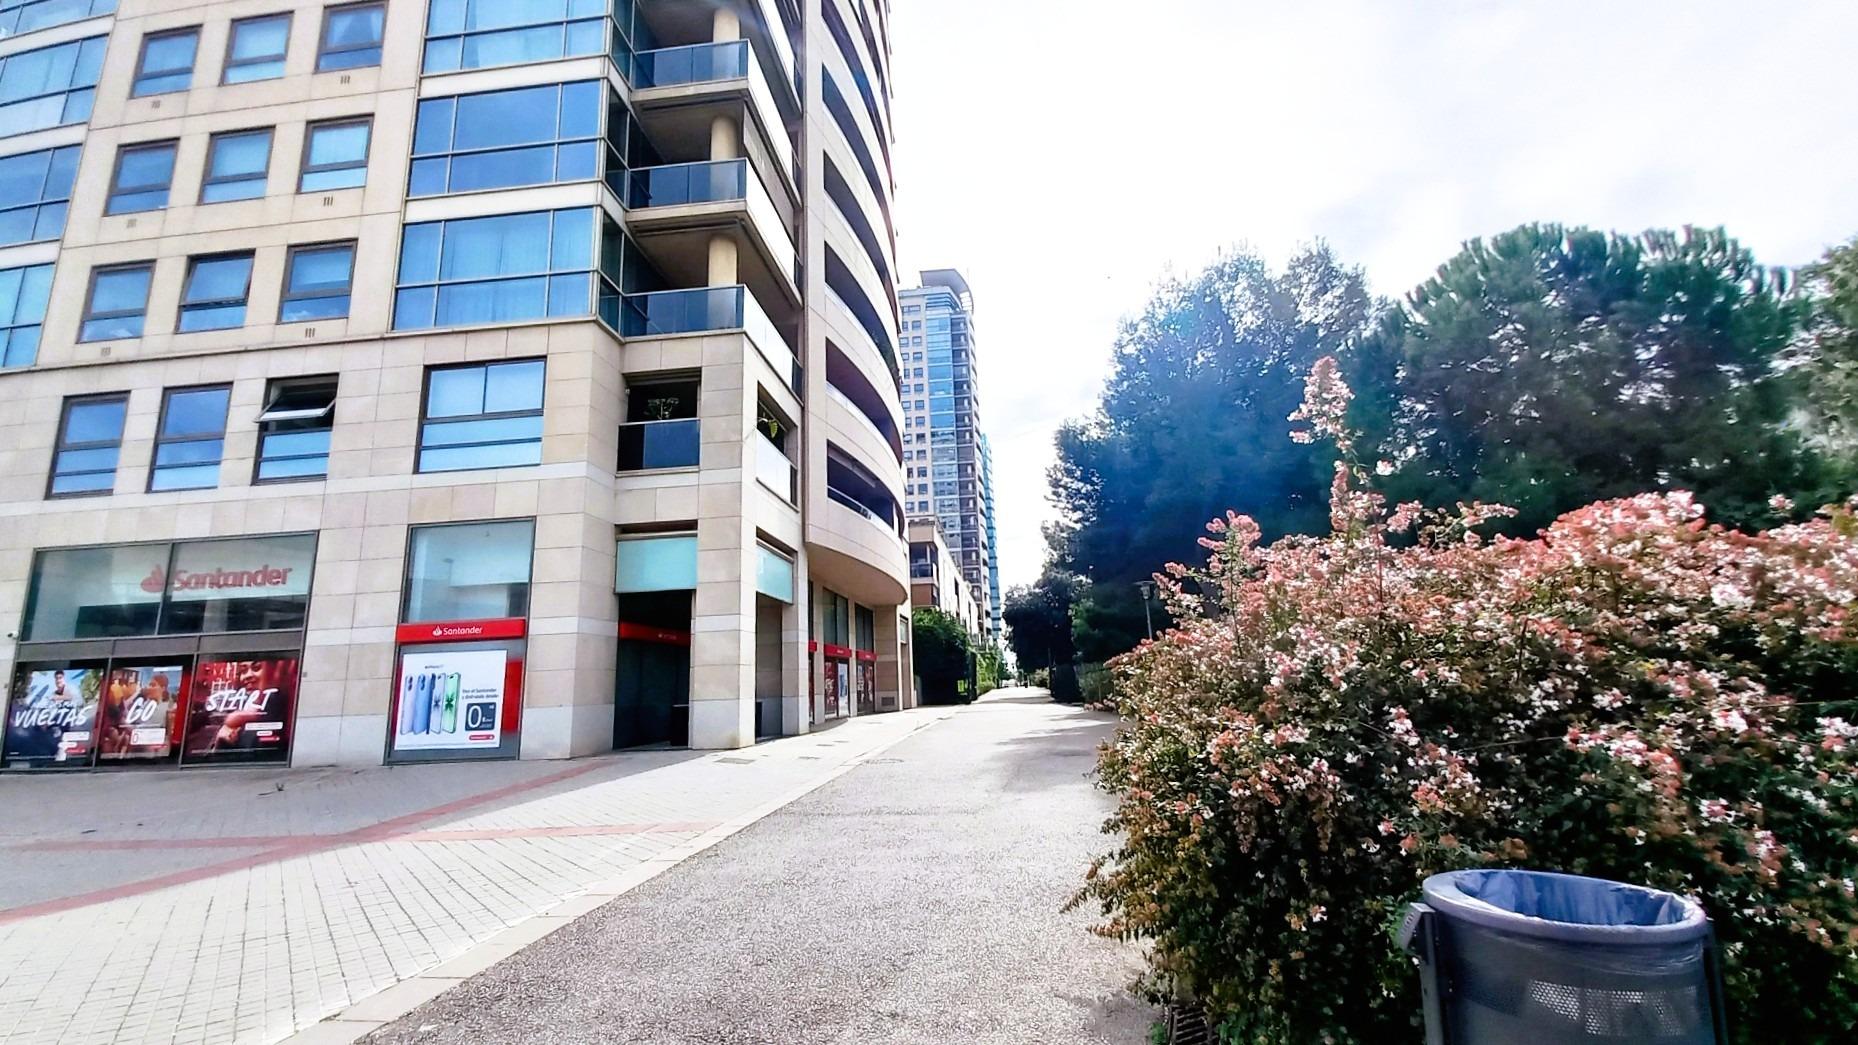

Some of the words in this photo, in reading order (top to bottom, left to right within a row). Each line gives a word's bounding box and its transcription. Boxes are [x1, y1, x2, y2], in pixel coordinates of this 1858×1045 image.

[173, 564, 293, 591] Santander
[443, 626, 482, 635] Santander
[125, 696, 157, 724] GO
[206, 687, 279, 712] START
[14, 705, 94, 728] VUELTAS
